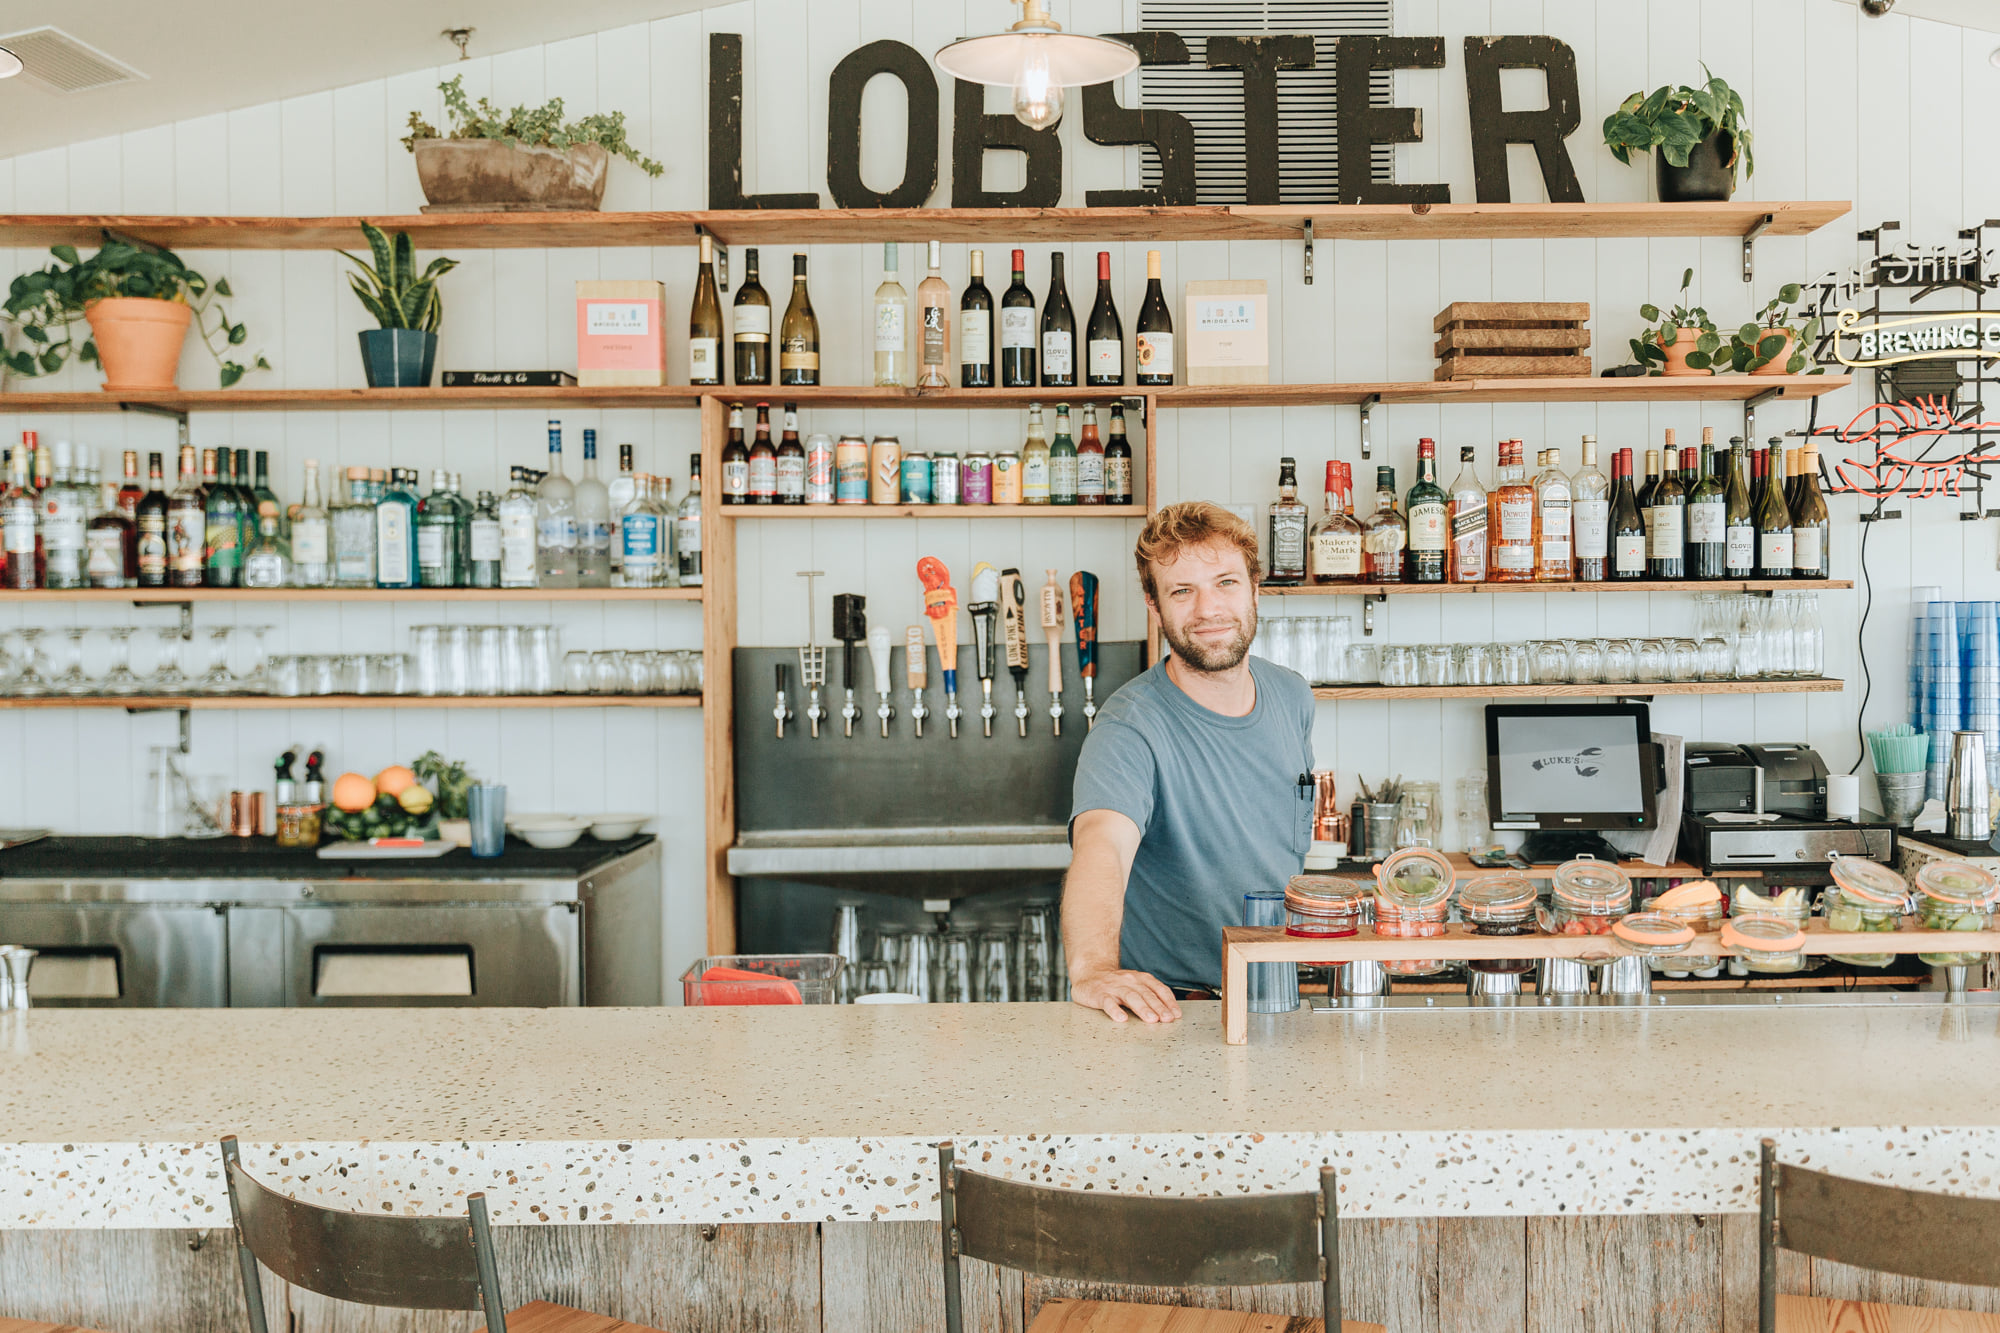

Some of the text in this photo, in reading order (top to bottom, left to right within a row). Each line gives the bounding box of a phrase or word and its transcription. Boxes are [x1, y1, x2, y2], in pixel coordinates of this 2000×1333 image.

[708, 33, 1584, 209] LOBSTER
[1803, 241, 2000, 317] THE SHIPY
[1861, 324, 1979, 357] BREWING
[1319, 539, 1357, 547] Maker's
[1330, 547, 1357, 555] Mark
[1006, 624, 1019, 662] LONE PINE
[1542, 756, 1581, 766] LUKE'S
